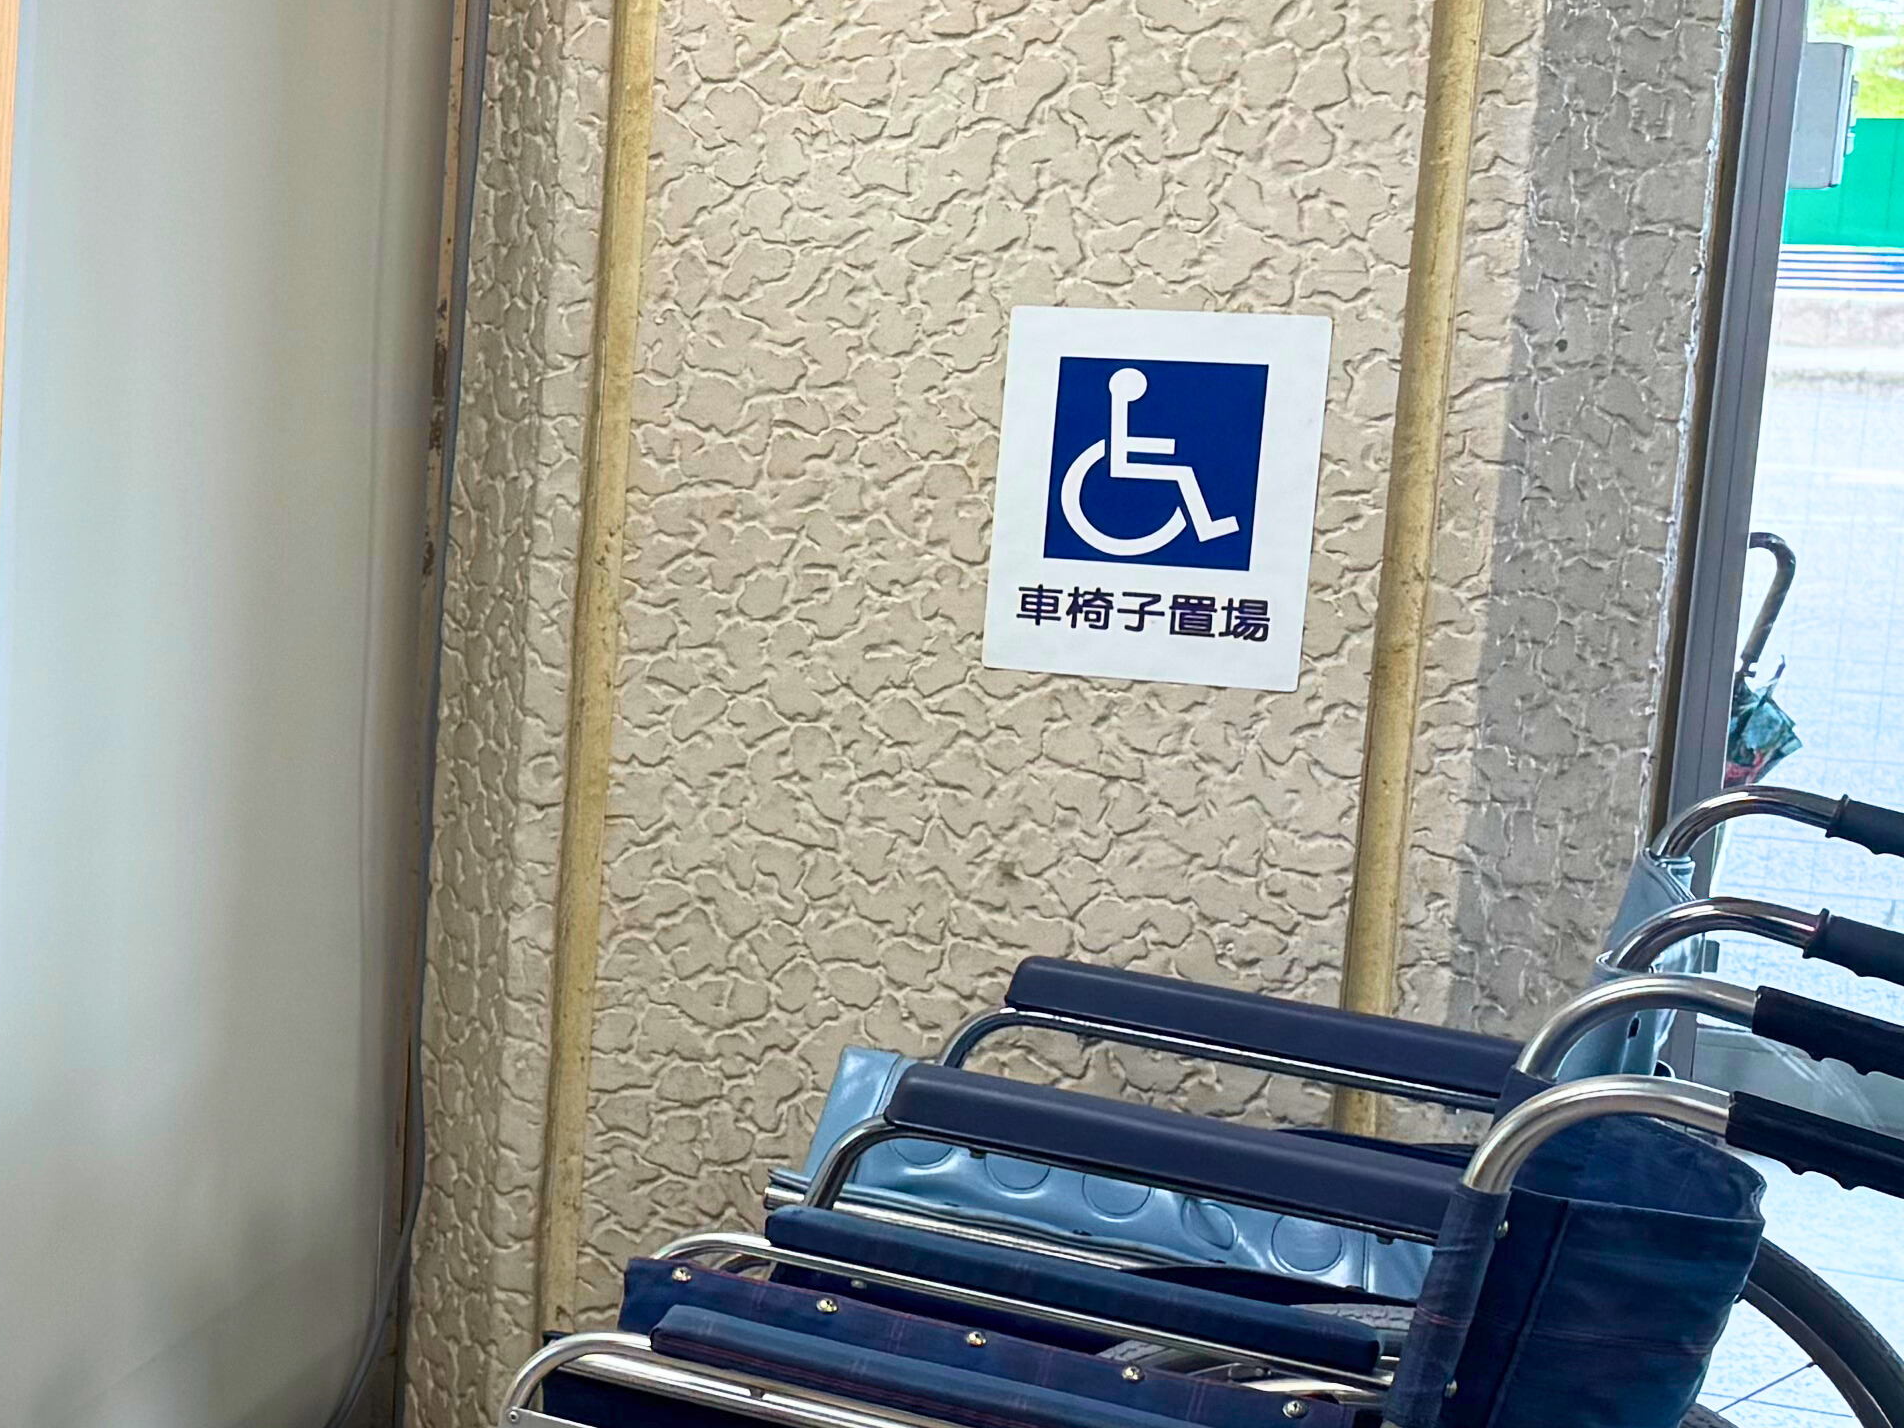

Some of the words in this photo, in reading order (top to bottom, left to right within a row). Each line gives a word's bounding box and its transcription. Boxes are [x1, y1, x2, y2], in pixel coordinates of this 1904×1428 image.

[1015, 583, 1271, 643] 車椅子置場
